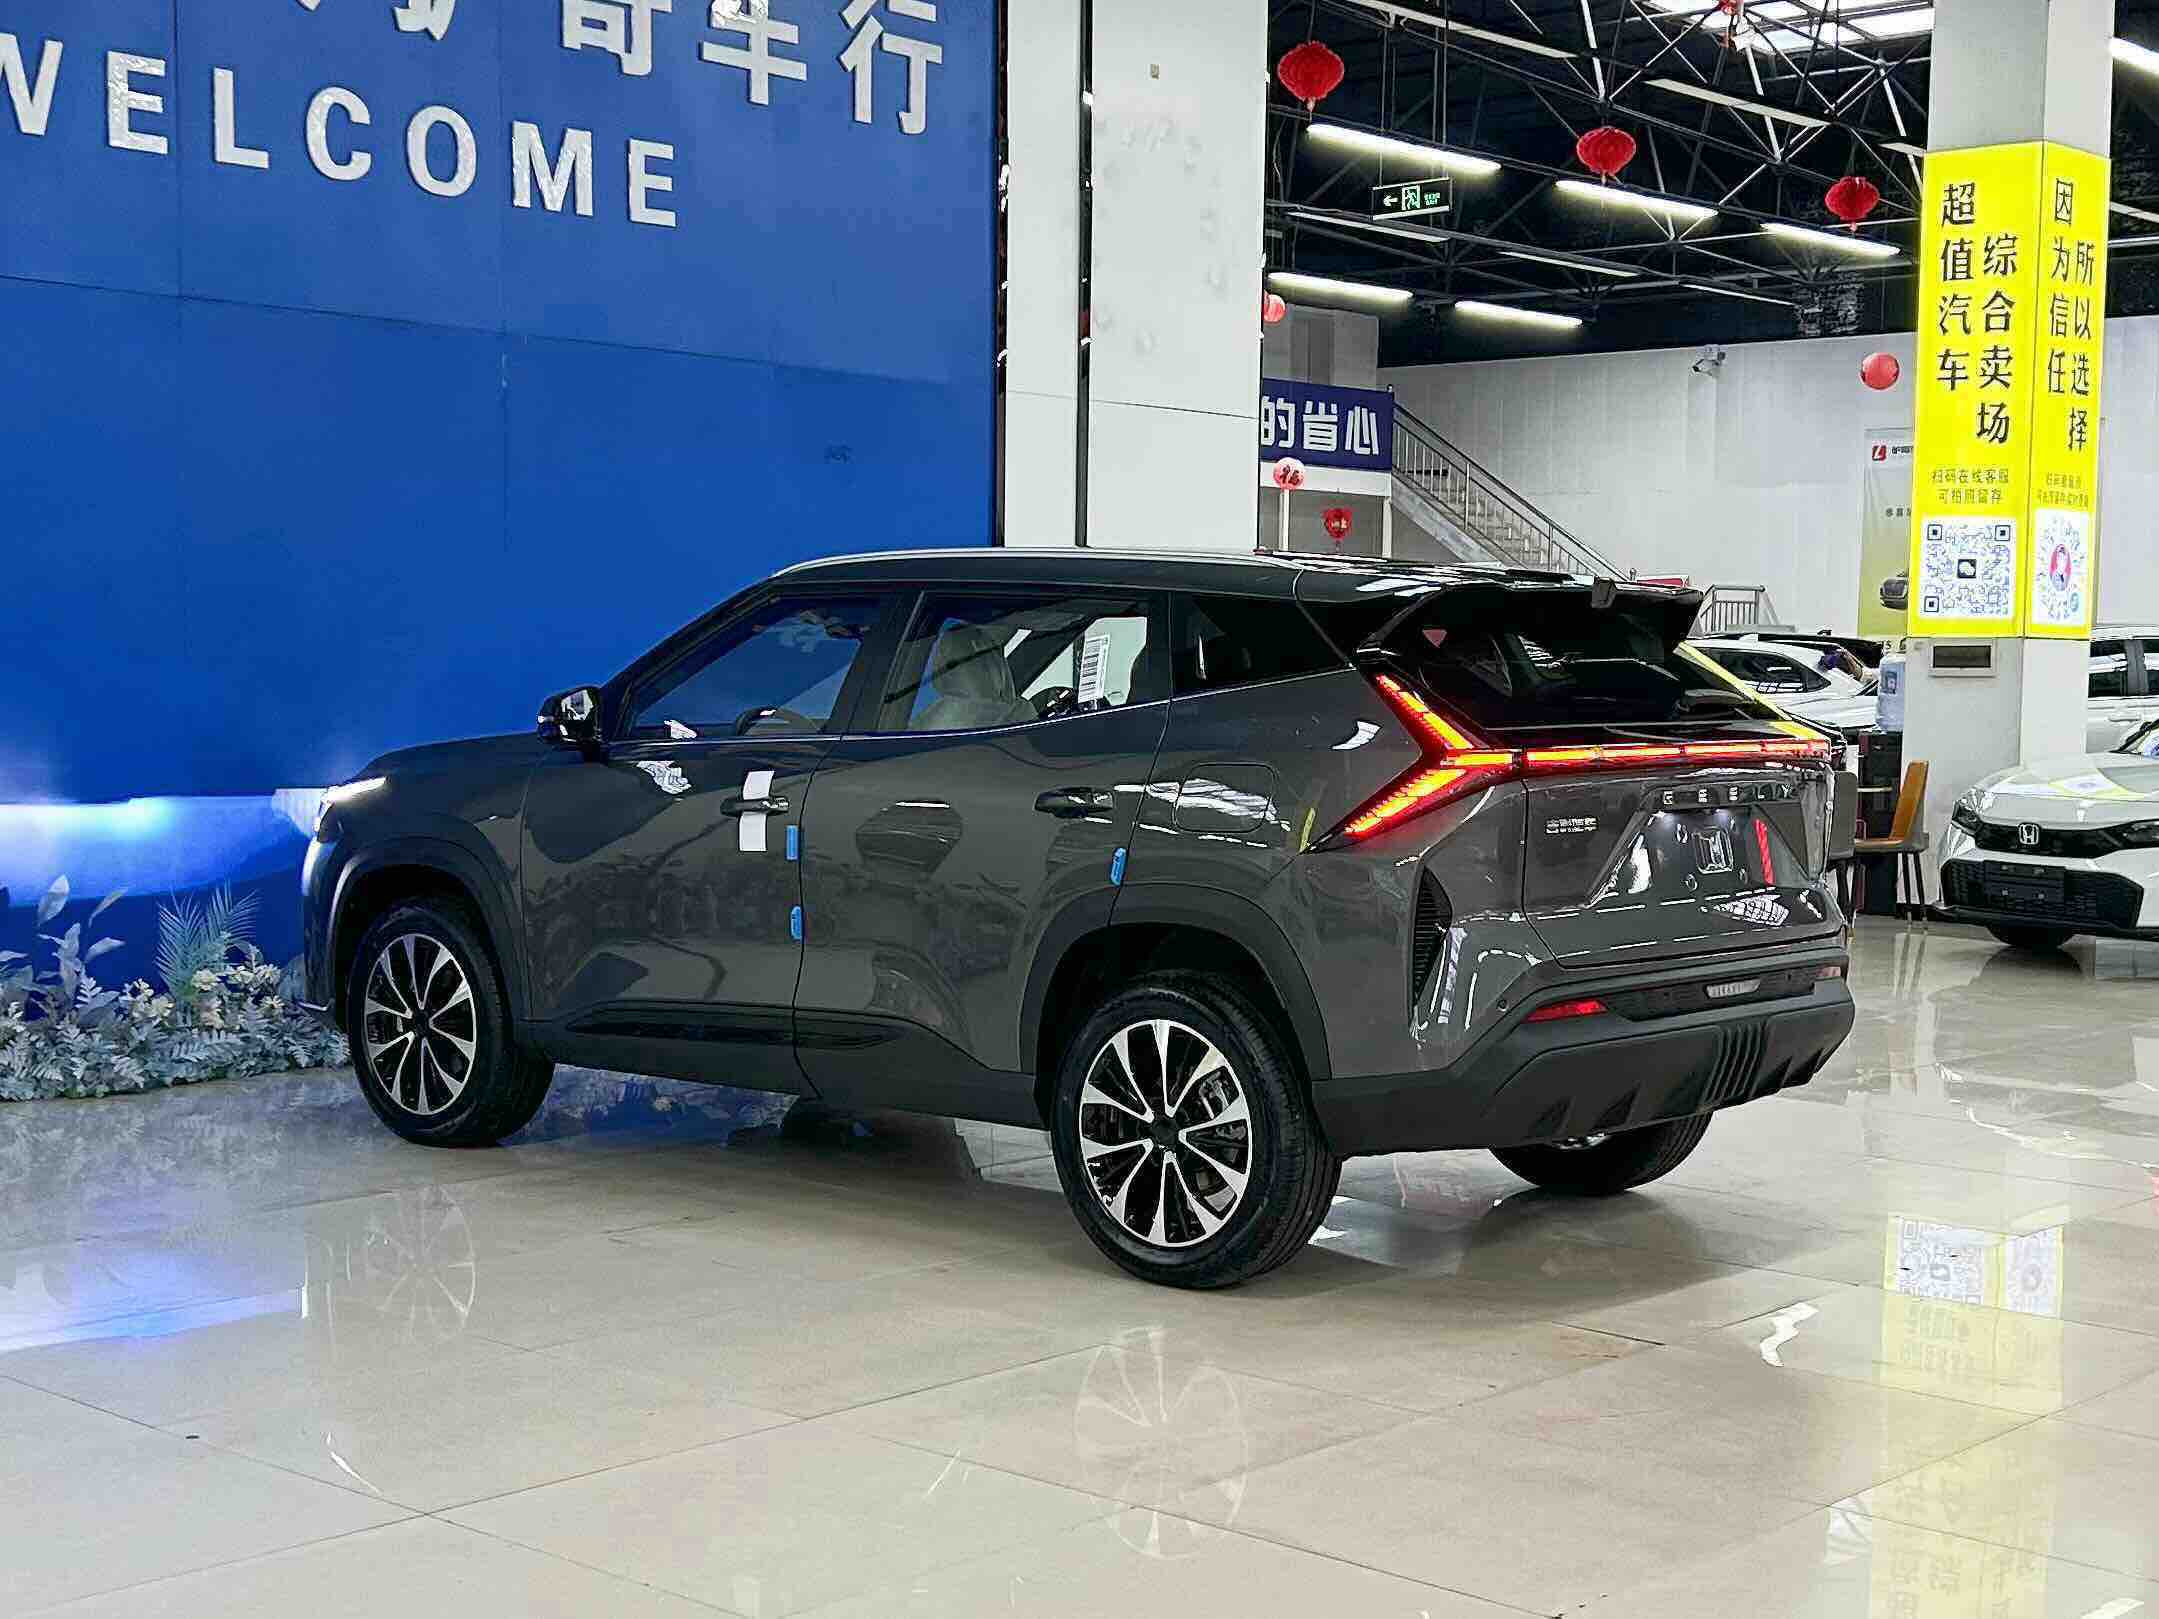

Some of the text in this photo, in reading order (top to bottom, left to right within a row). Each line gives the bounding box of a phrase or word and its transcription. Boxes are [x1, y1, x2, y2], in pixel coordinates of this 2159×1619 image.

[0, 32, 677, 228] WELCOME
[1936, 182, 1976, 391] 超值汽车
[1976, 233, 2018, 444] 综合卖场
[2047, 178, 2074, 394] 因为信任
[2067, 239, 2095, 453] 所以选择
